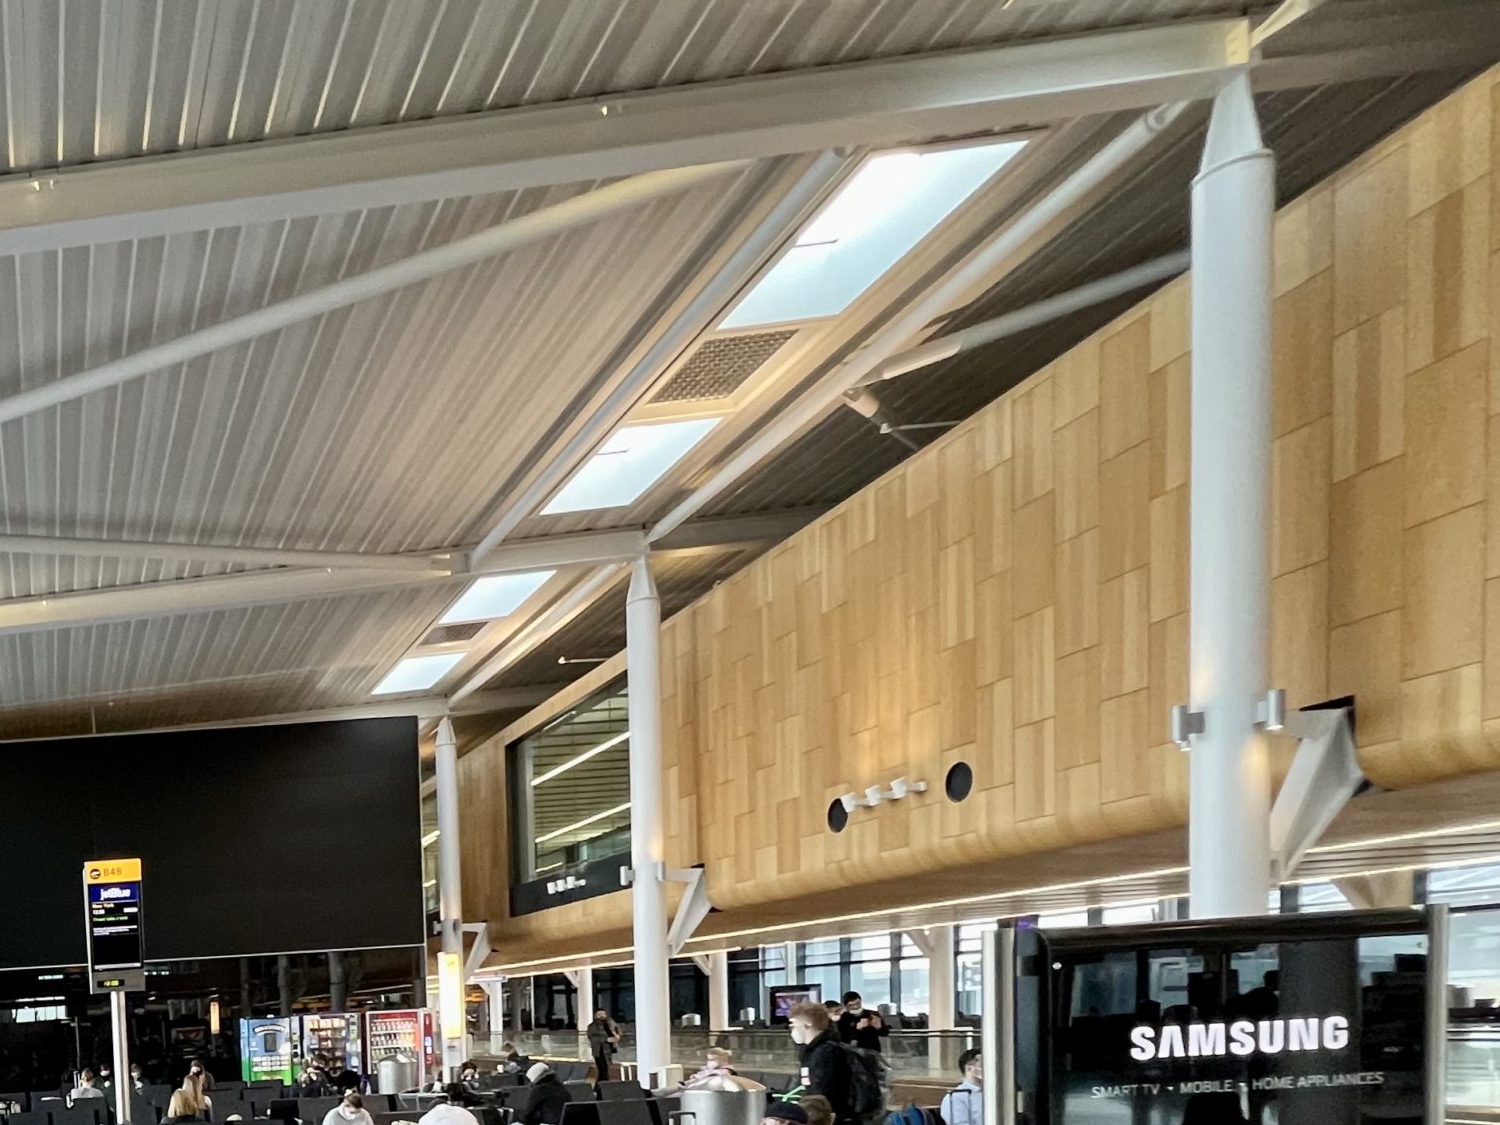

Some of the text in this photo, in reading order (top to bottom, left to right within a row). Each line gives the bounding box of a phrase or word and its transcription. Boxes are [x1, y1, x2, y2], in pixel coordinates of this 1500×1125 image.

[1130, 1015, 1349, 1061] SAMSUNG
[1091, 1071, 1385, 1099] SMART TV MOBILE HOME APPLIANCES
